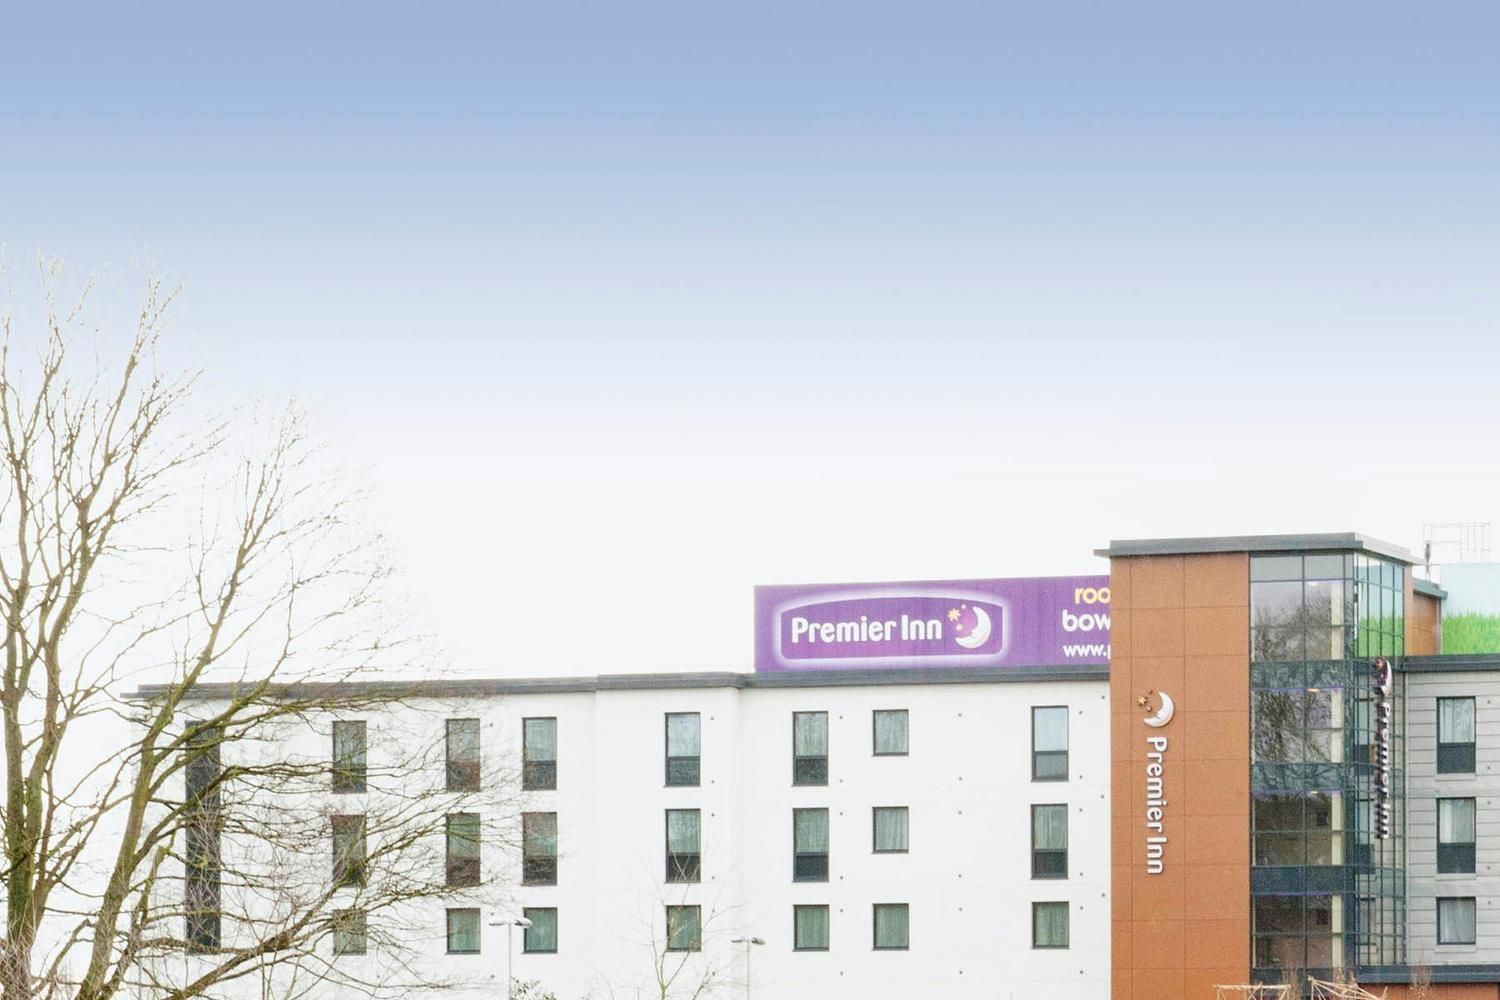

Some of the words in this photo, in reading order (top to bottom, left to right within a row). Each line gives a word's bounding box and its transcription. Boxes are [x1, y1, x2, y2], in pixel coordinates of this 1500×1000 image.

[791, 616, 897, 643] Premier
[901, 614, 942, 641] Inn
[1379, 701, 1391, 798] Premier
[1146, 736, 1168, 833] Premier
[1146, 836, 1168, 875] Inn
